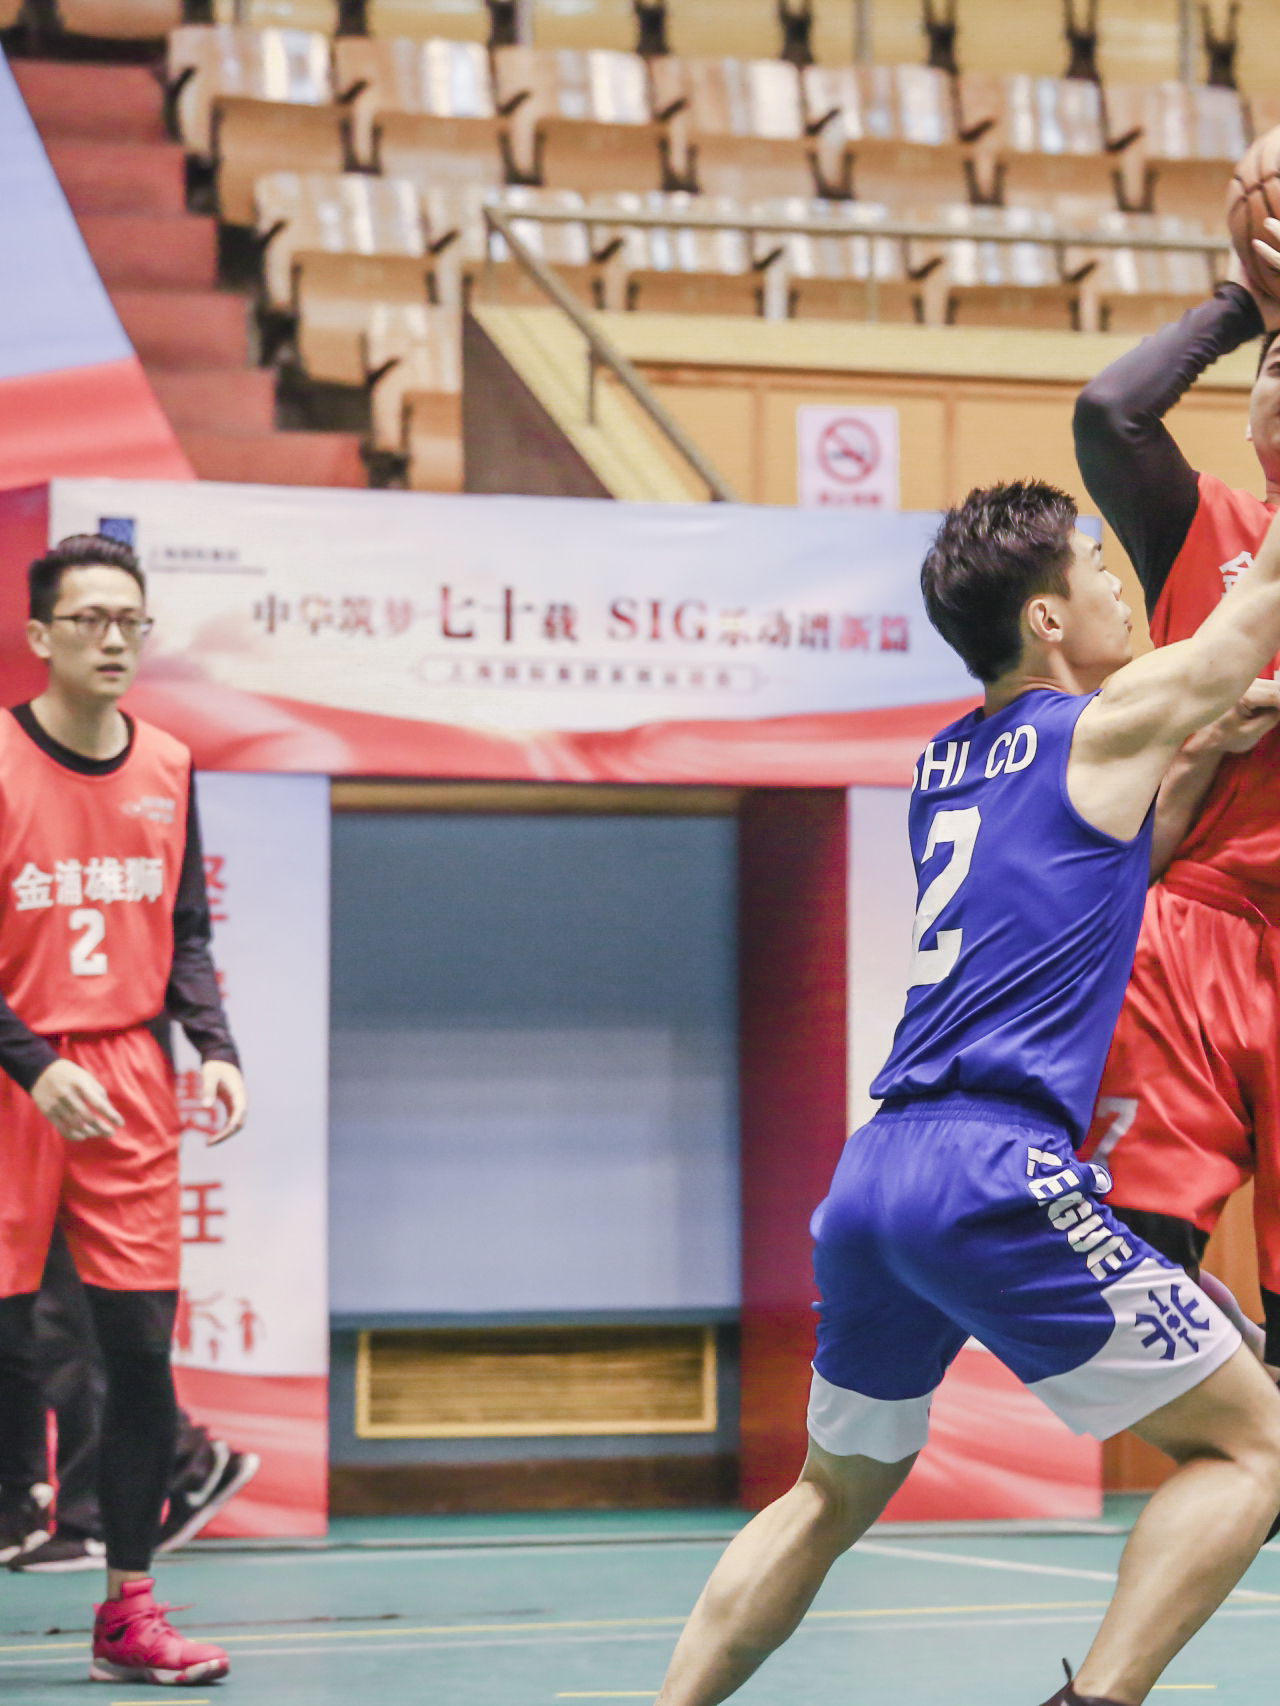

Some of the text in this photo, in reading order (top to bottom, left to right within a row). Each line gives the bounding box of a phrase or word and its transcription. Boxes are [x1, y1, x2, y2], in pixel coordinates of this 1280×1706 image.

[911, 724, 1039, 795] HI CD
[906, 806, 982, 988] 2
[69, 908, 108, 976] 2
[1086, 1096, 1139, 1169] 7
